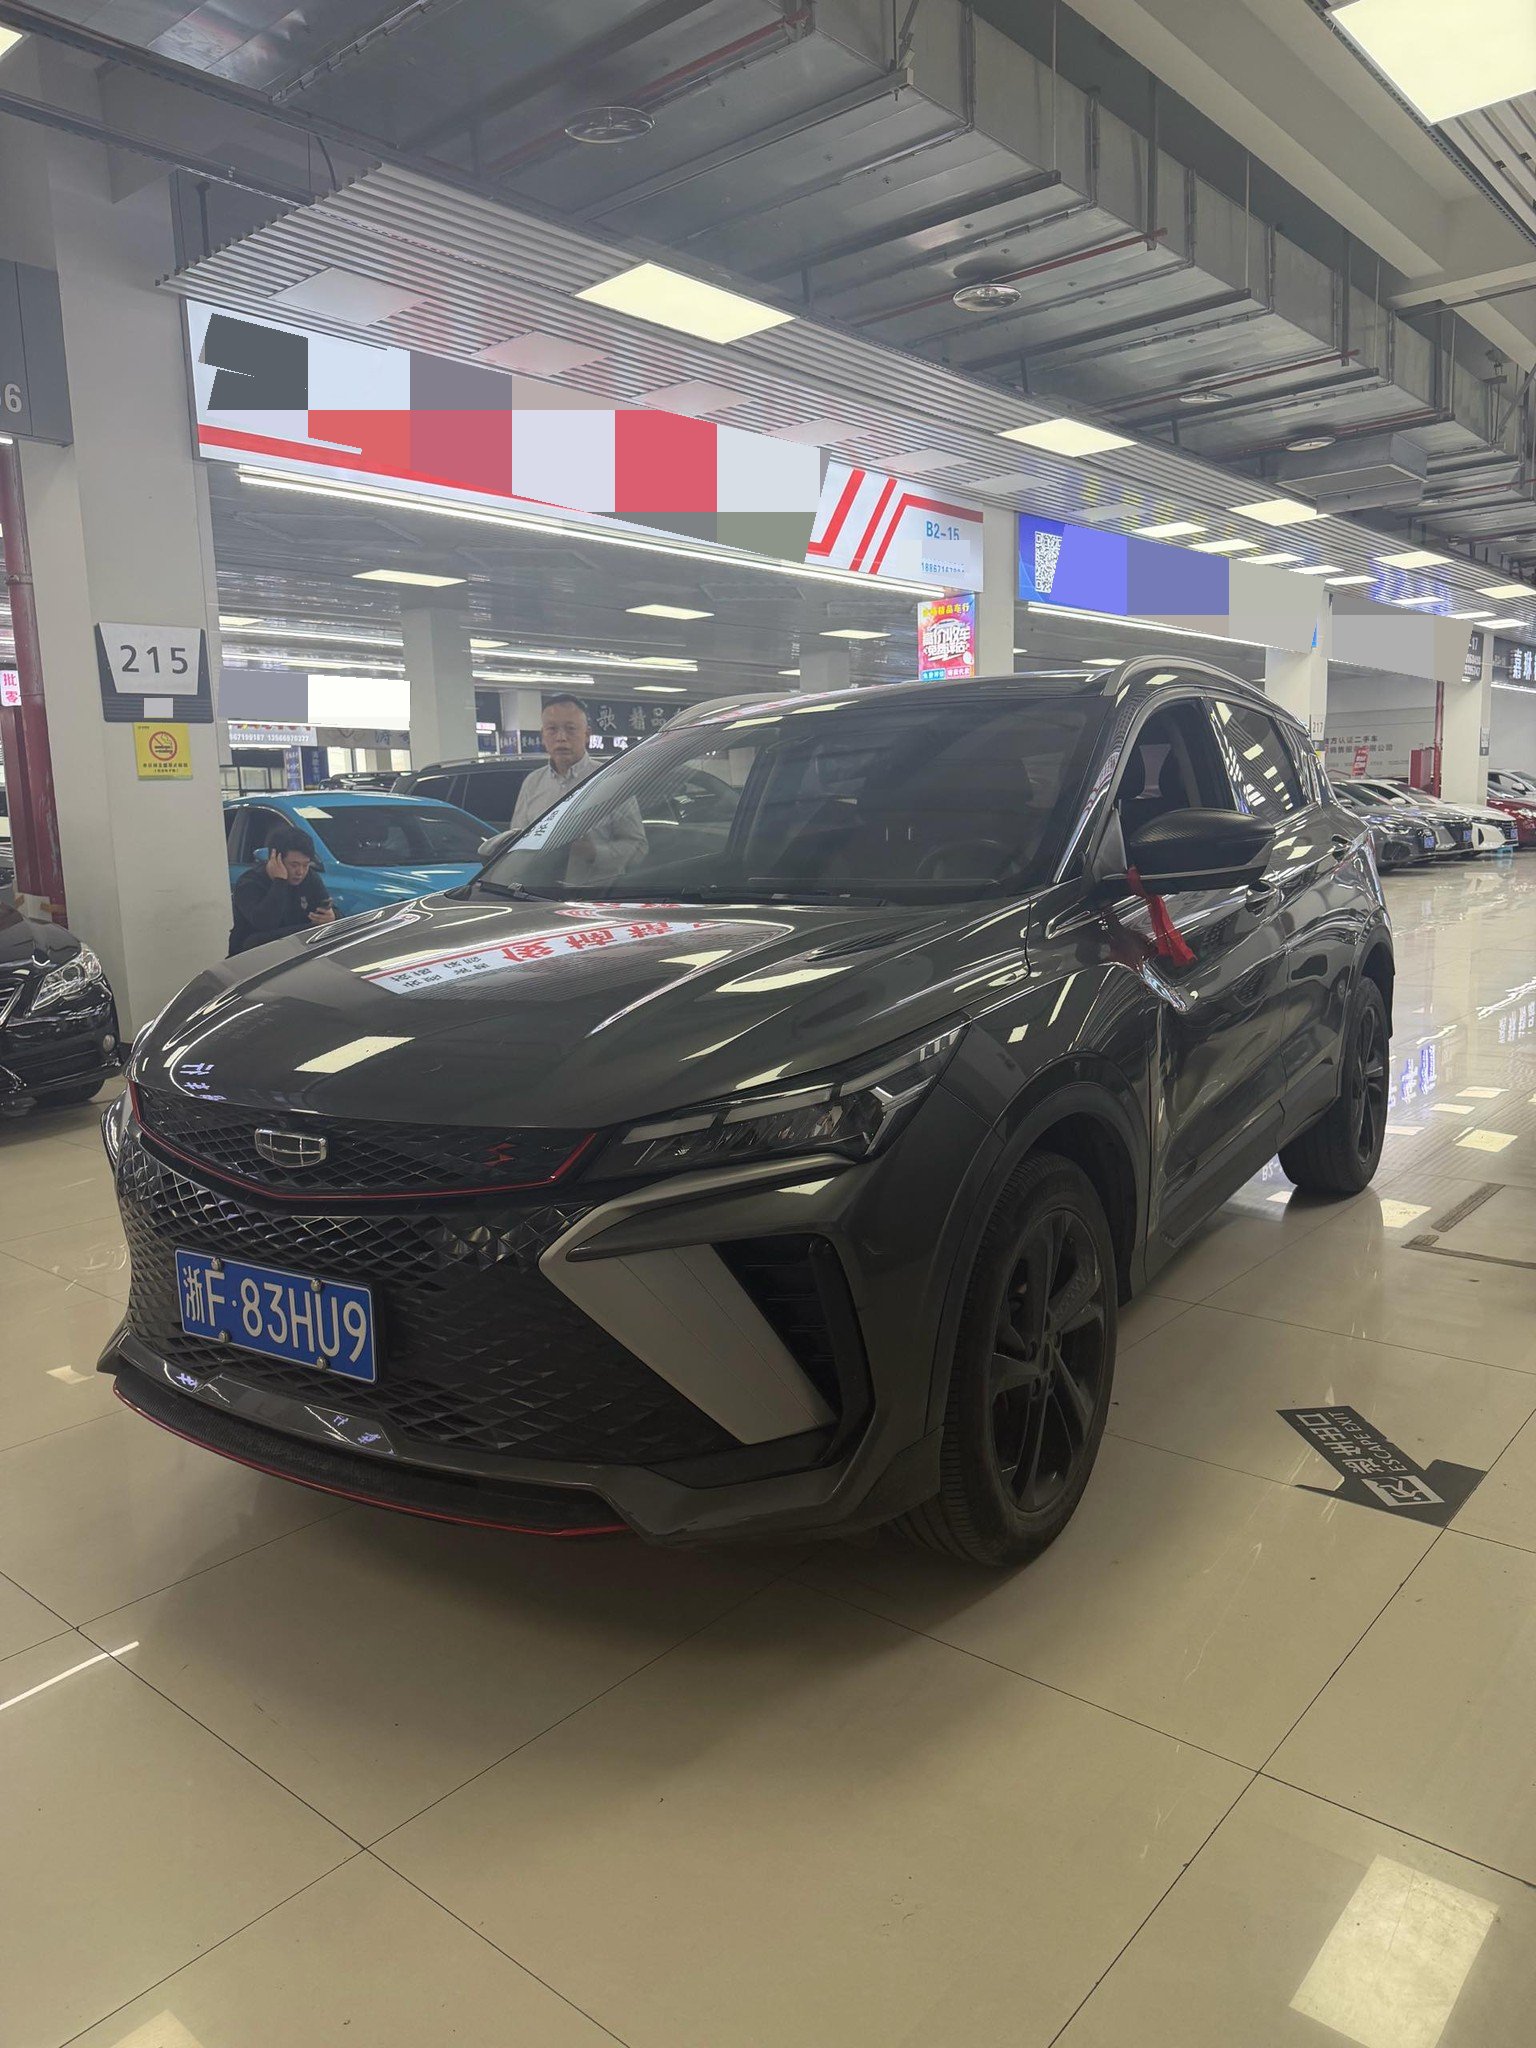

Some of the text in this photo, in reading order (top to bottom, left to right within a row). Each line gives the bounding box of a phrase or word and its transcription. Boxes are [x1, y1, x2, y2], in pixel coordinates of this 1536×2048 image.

[120, 643, 189, 675] 215
[1295, 1412, 1385, 1475] 逃生出口
[1328, 1411, 1408, 1472] ESCAPE EXIT
